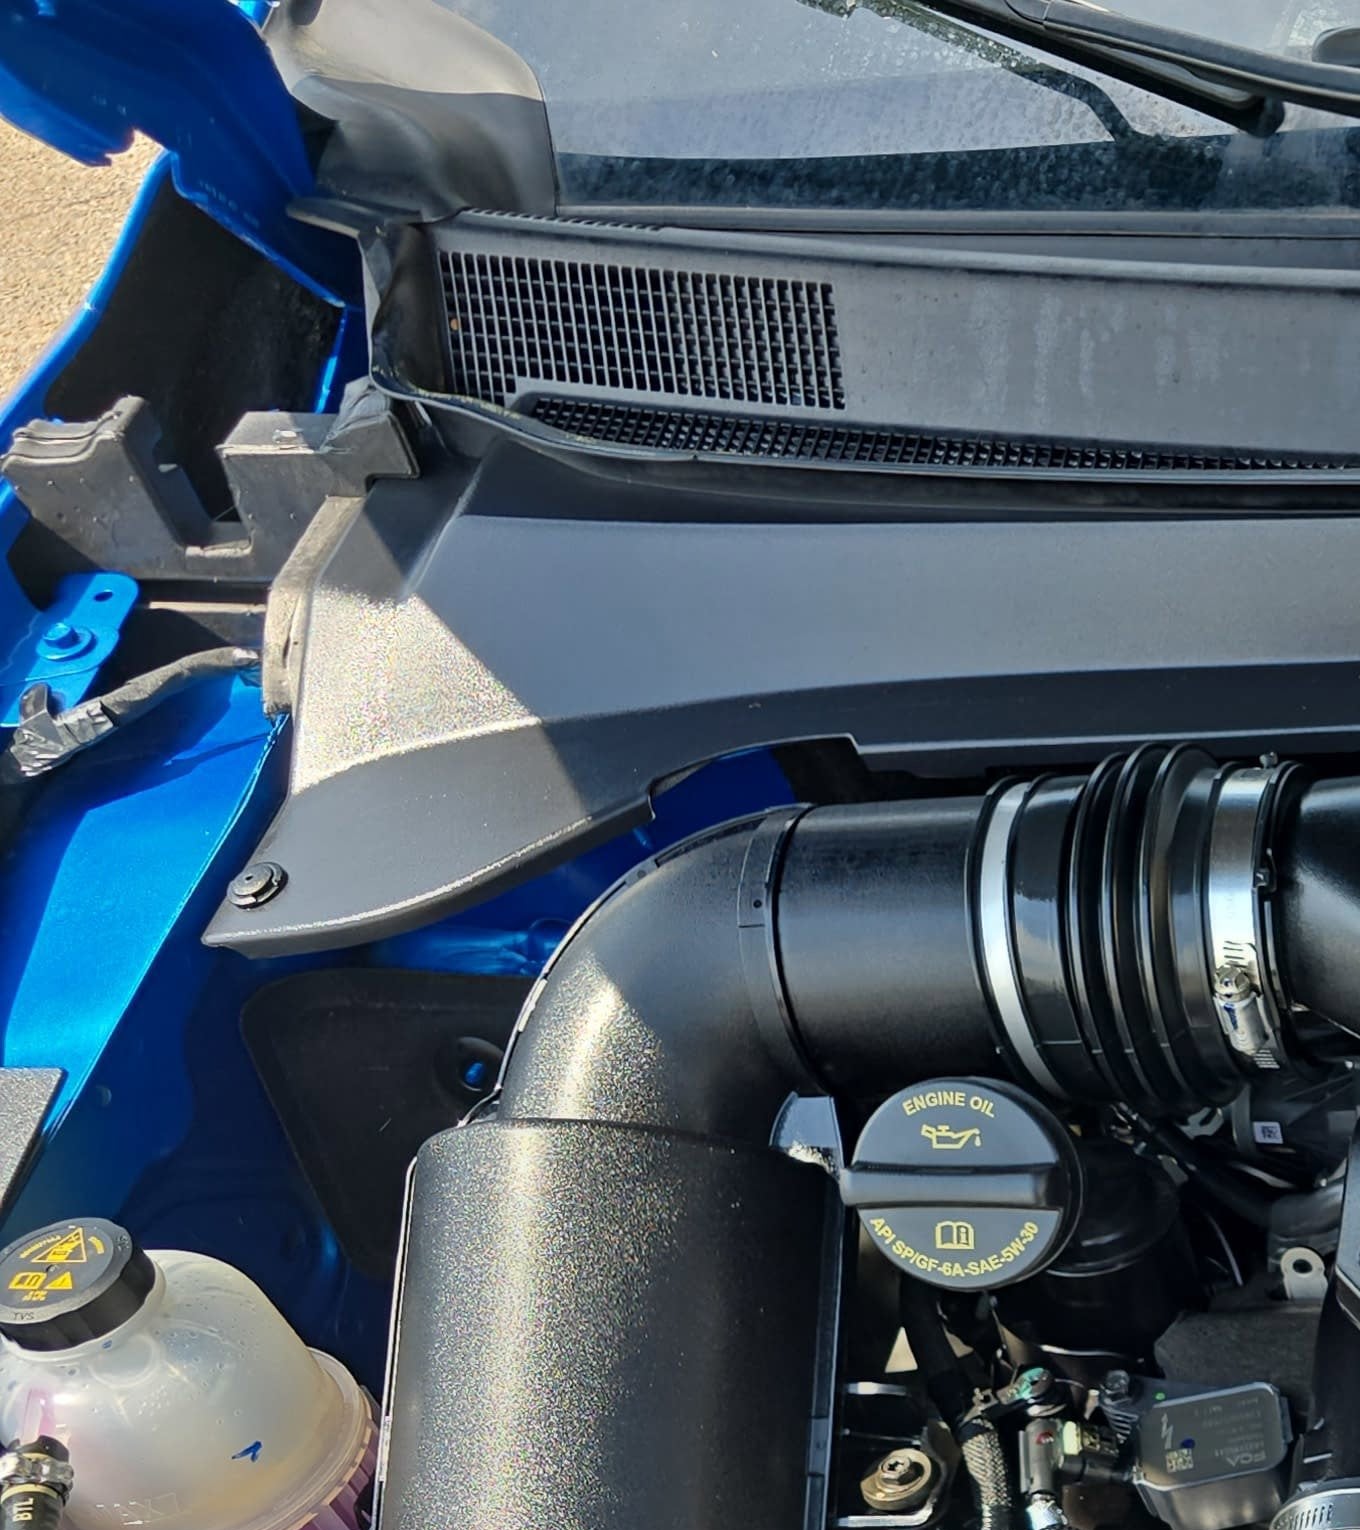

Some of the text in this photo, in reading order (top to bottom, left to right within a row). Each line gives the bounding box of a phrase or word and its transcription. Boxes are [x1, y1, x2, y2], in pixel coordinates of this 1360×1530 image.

[902, 1091, 996, 1118] ENGINE OIL
[870, 1216, 895, 1244] API
[12, 1496, 34, 1522] BTL
